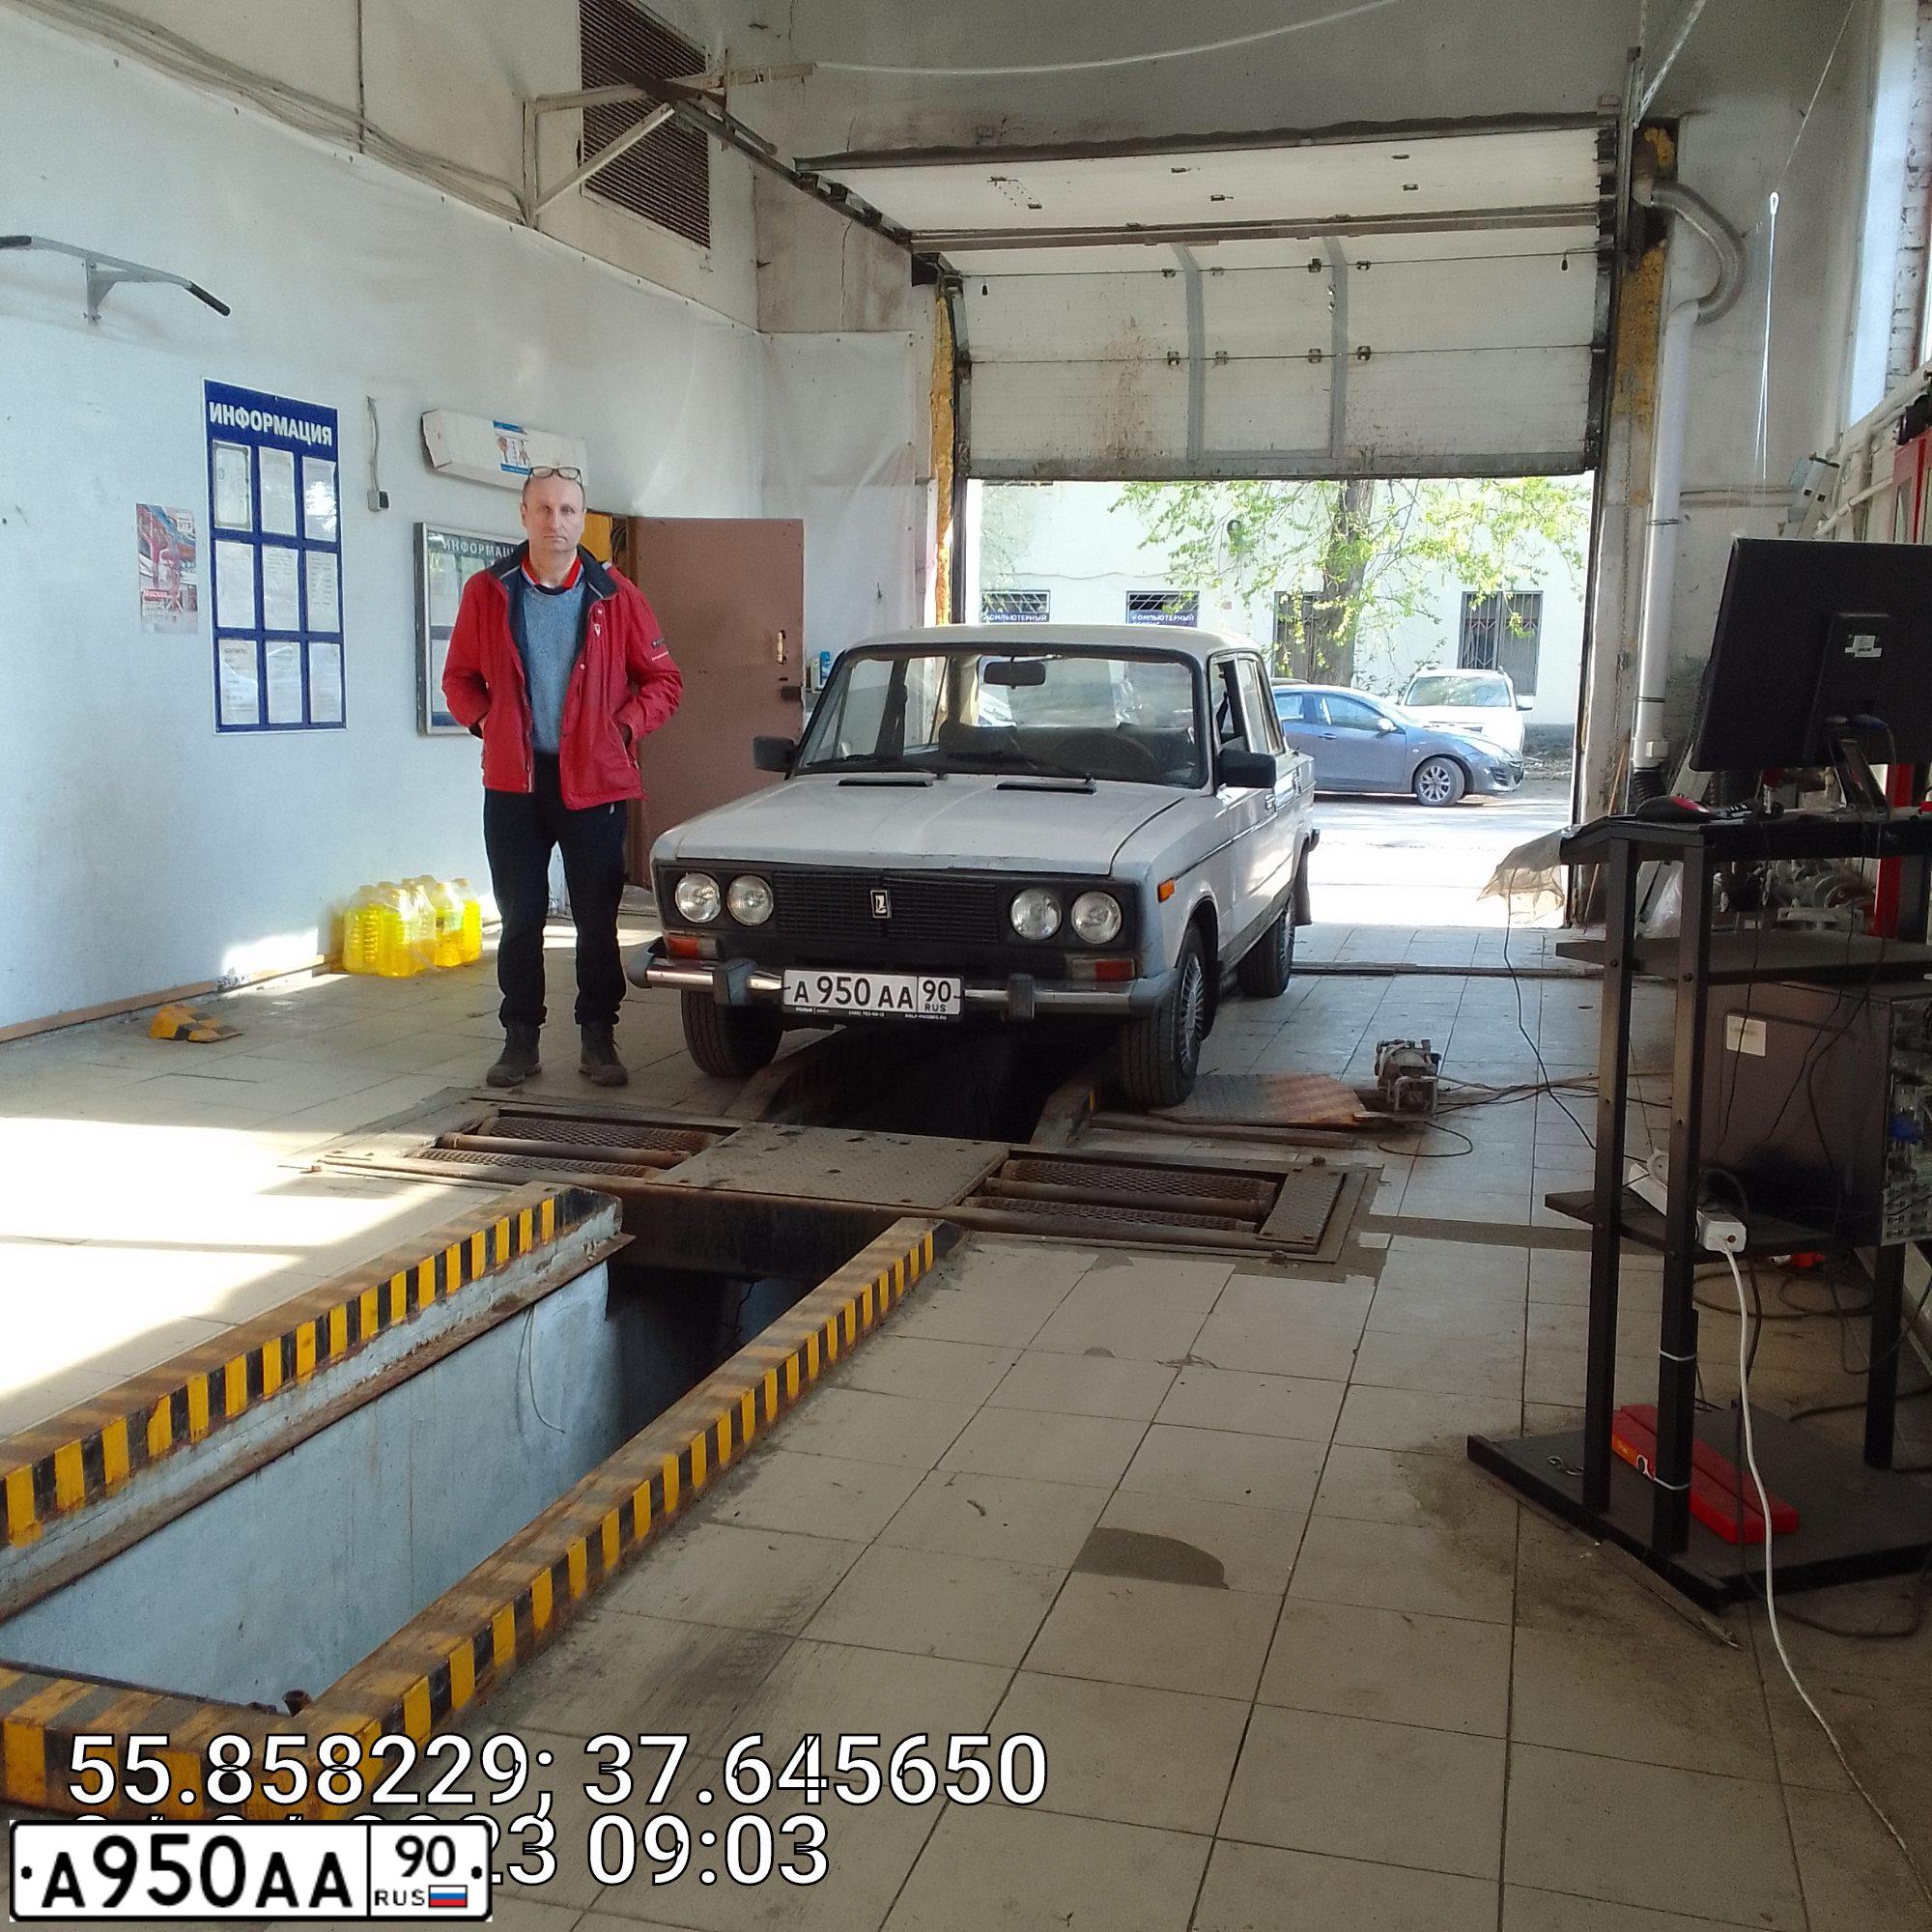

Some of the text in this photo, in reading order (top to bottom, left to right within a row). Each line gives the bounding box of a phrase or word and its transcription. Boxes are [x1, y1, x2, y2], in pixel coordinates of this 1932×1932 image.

[209, 402, 332, 446] ИНФОРМАЦИЯ
[442, 539, 514, 558] ИНФОРМАЦ
[923, 980, 952, 1003] 90
[924, 1004, 947, 1012] RUS
